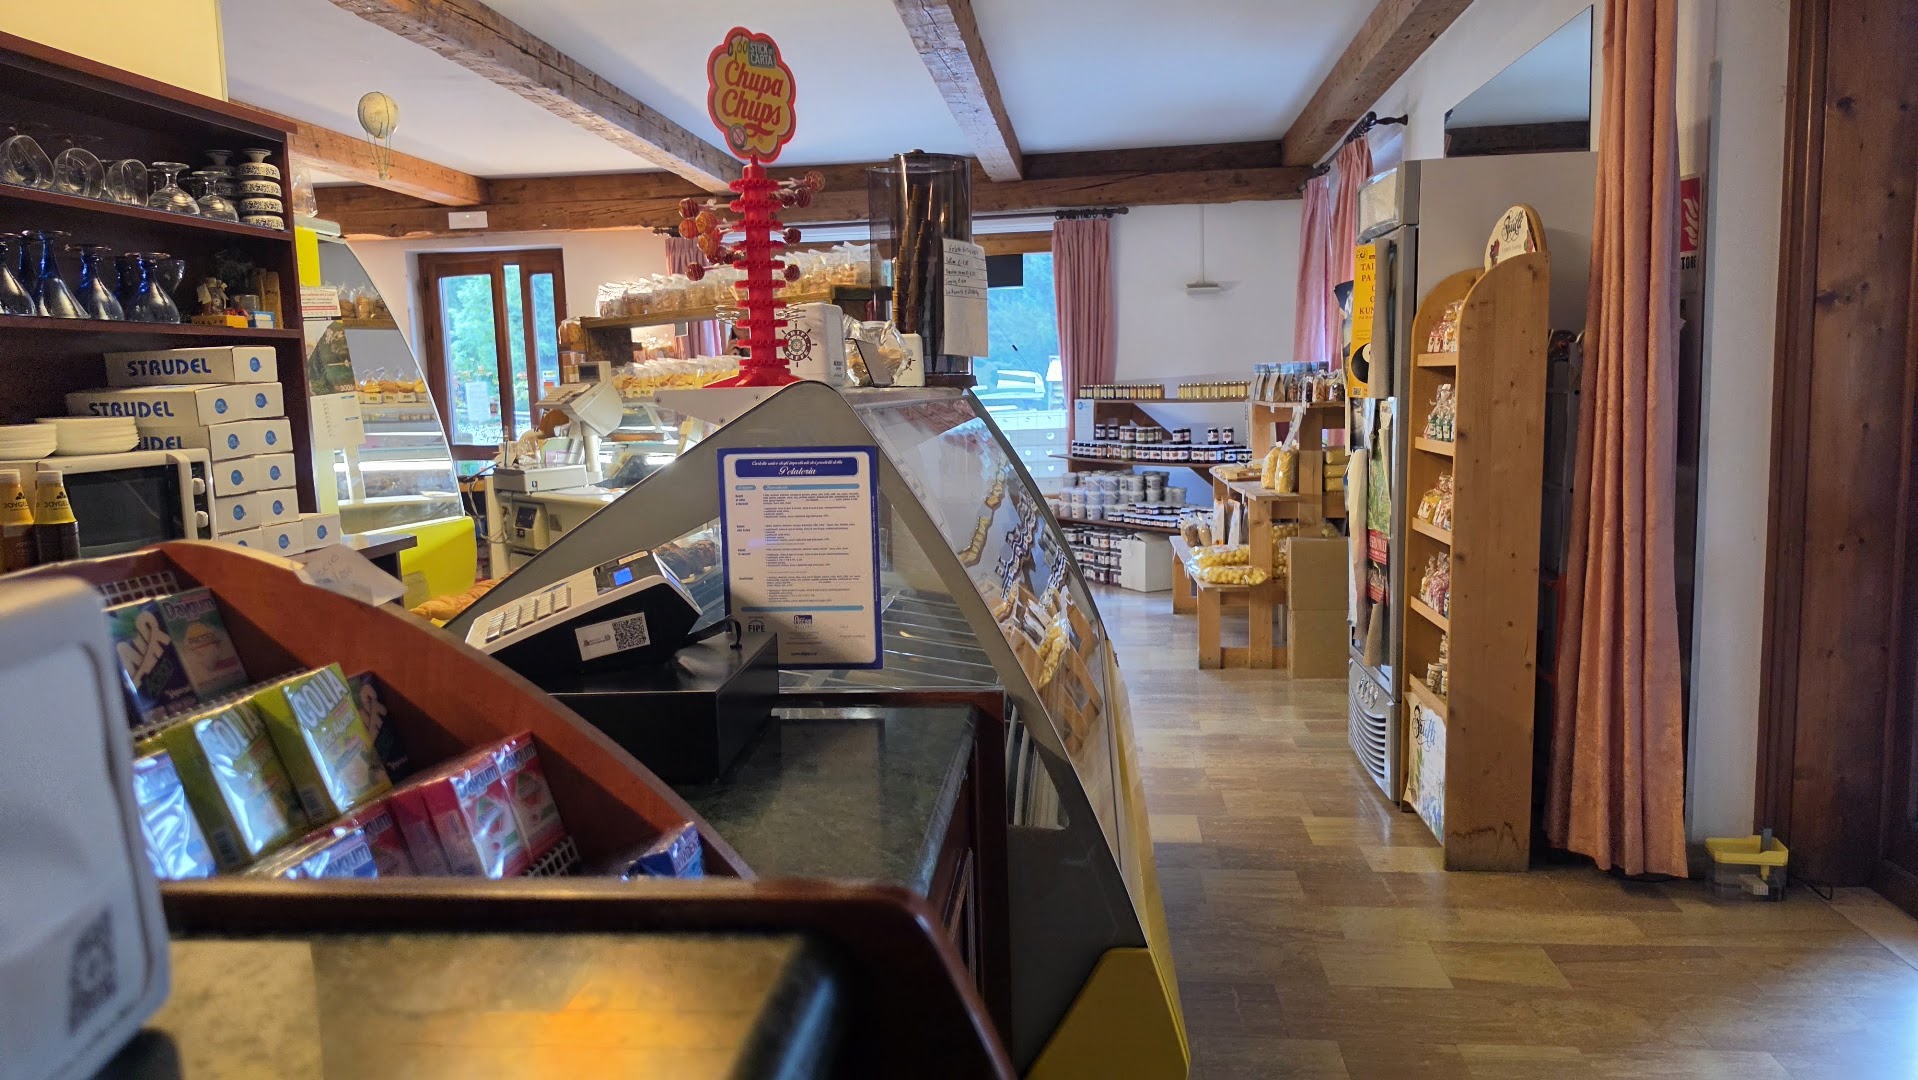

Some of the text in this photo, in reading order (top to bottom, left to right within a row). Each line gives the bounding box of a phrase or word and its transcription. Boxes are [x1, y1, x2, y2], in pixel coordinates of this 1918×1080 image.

[750, 42, 768, 54] STICK
[750, 54, 774, 66] CARTA
[725, 60, 784, 100] Chupa
[721, 89, 782, 137] Chups
[1680, 255, 1697, 269] TORE
[127, 358, 211, 377] STRUDEL
[88, 401, 174, 418] STRUDEL
[748, 624, 766, 632] FIPE
[206, 703, 260, 764] OLIA
[456, 764, 500, 800] Daygum
